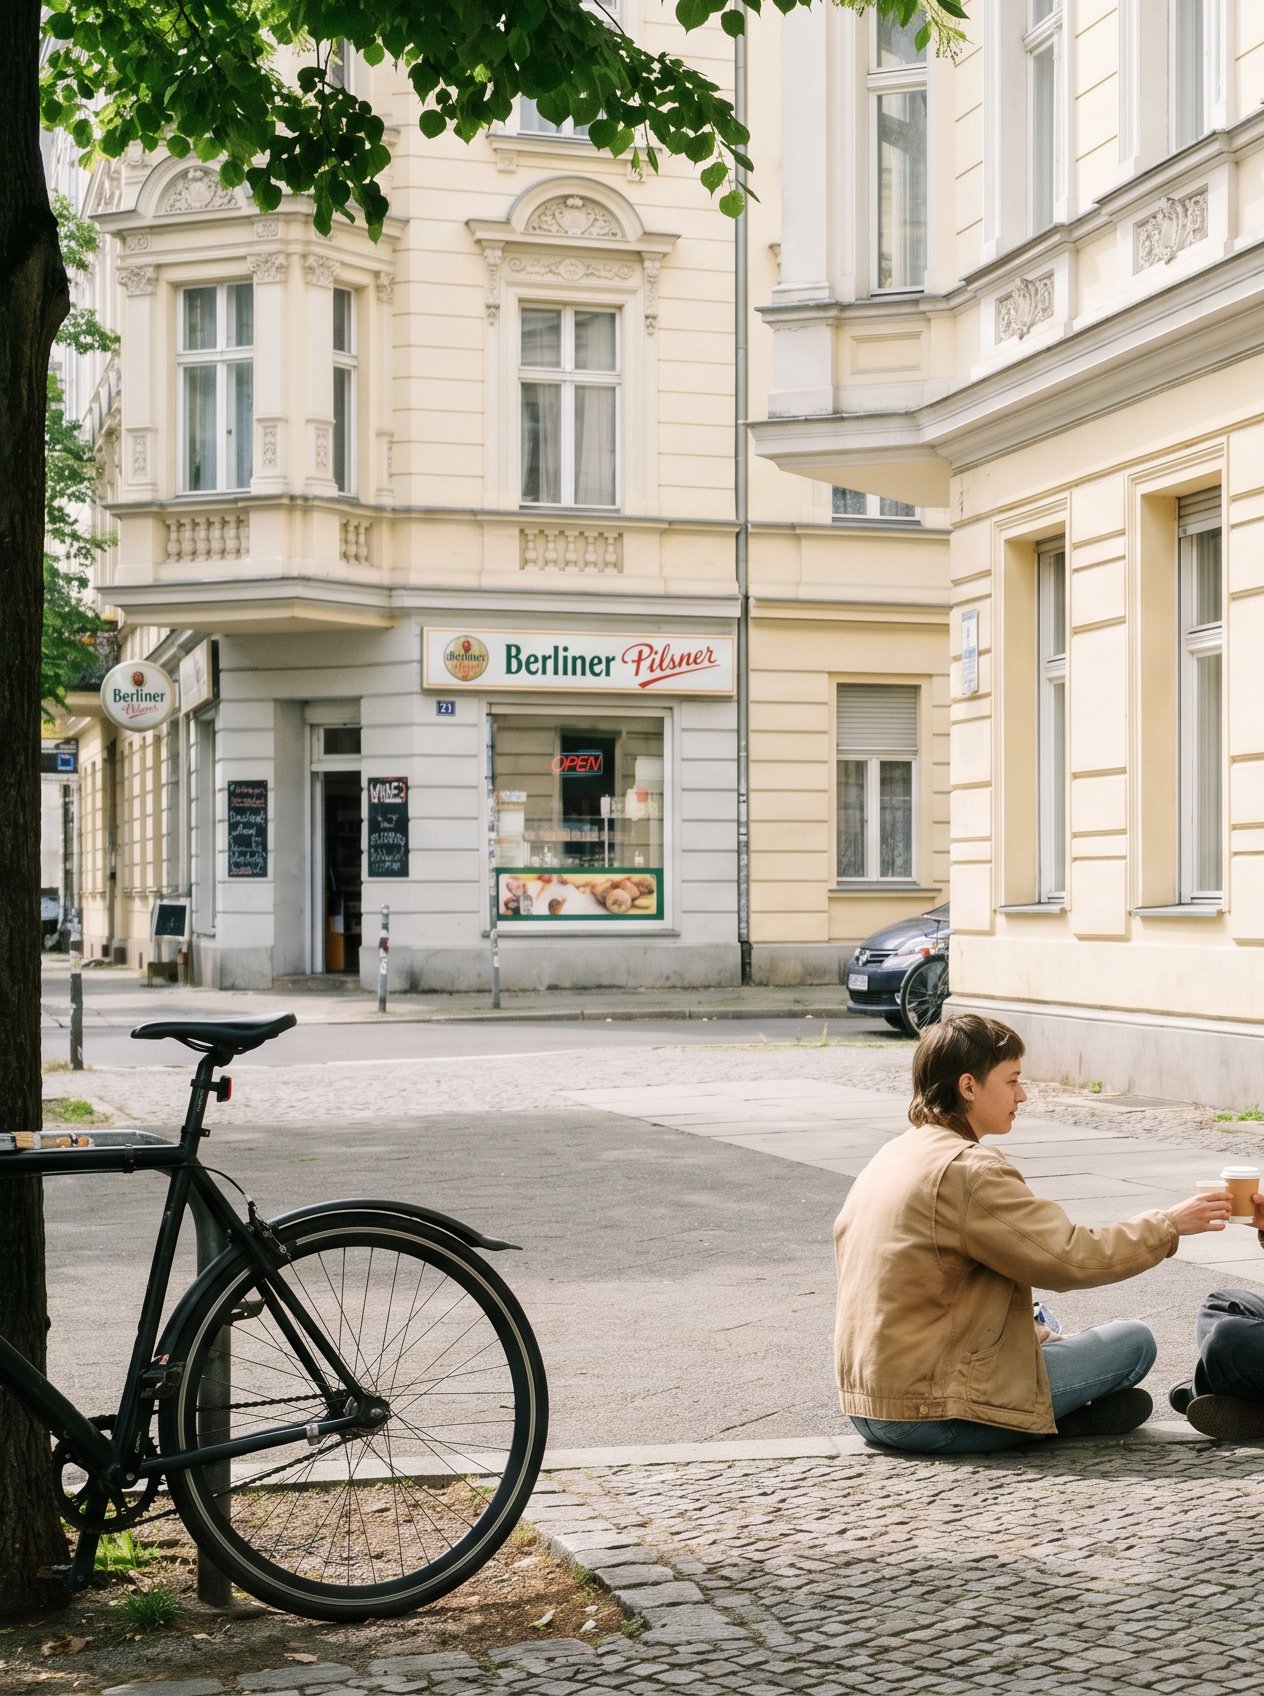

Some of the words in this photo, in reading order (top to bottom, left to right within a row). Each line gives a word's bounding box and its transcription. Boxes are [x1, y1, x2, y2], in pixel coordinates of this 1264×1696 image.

[505, 643, 616, 677] Berliner
[621, 642, 719, 679] Pilsner
[113, 688, 166, 703] Berliner
[551, 755, 602, 772] OPEN
